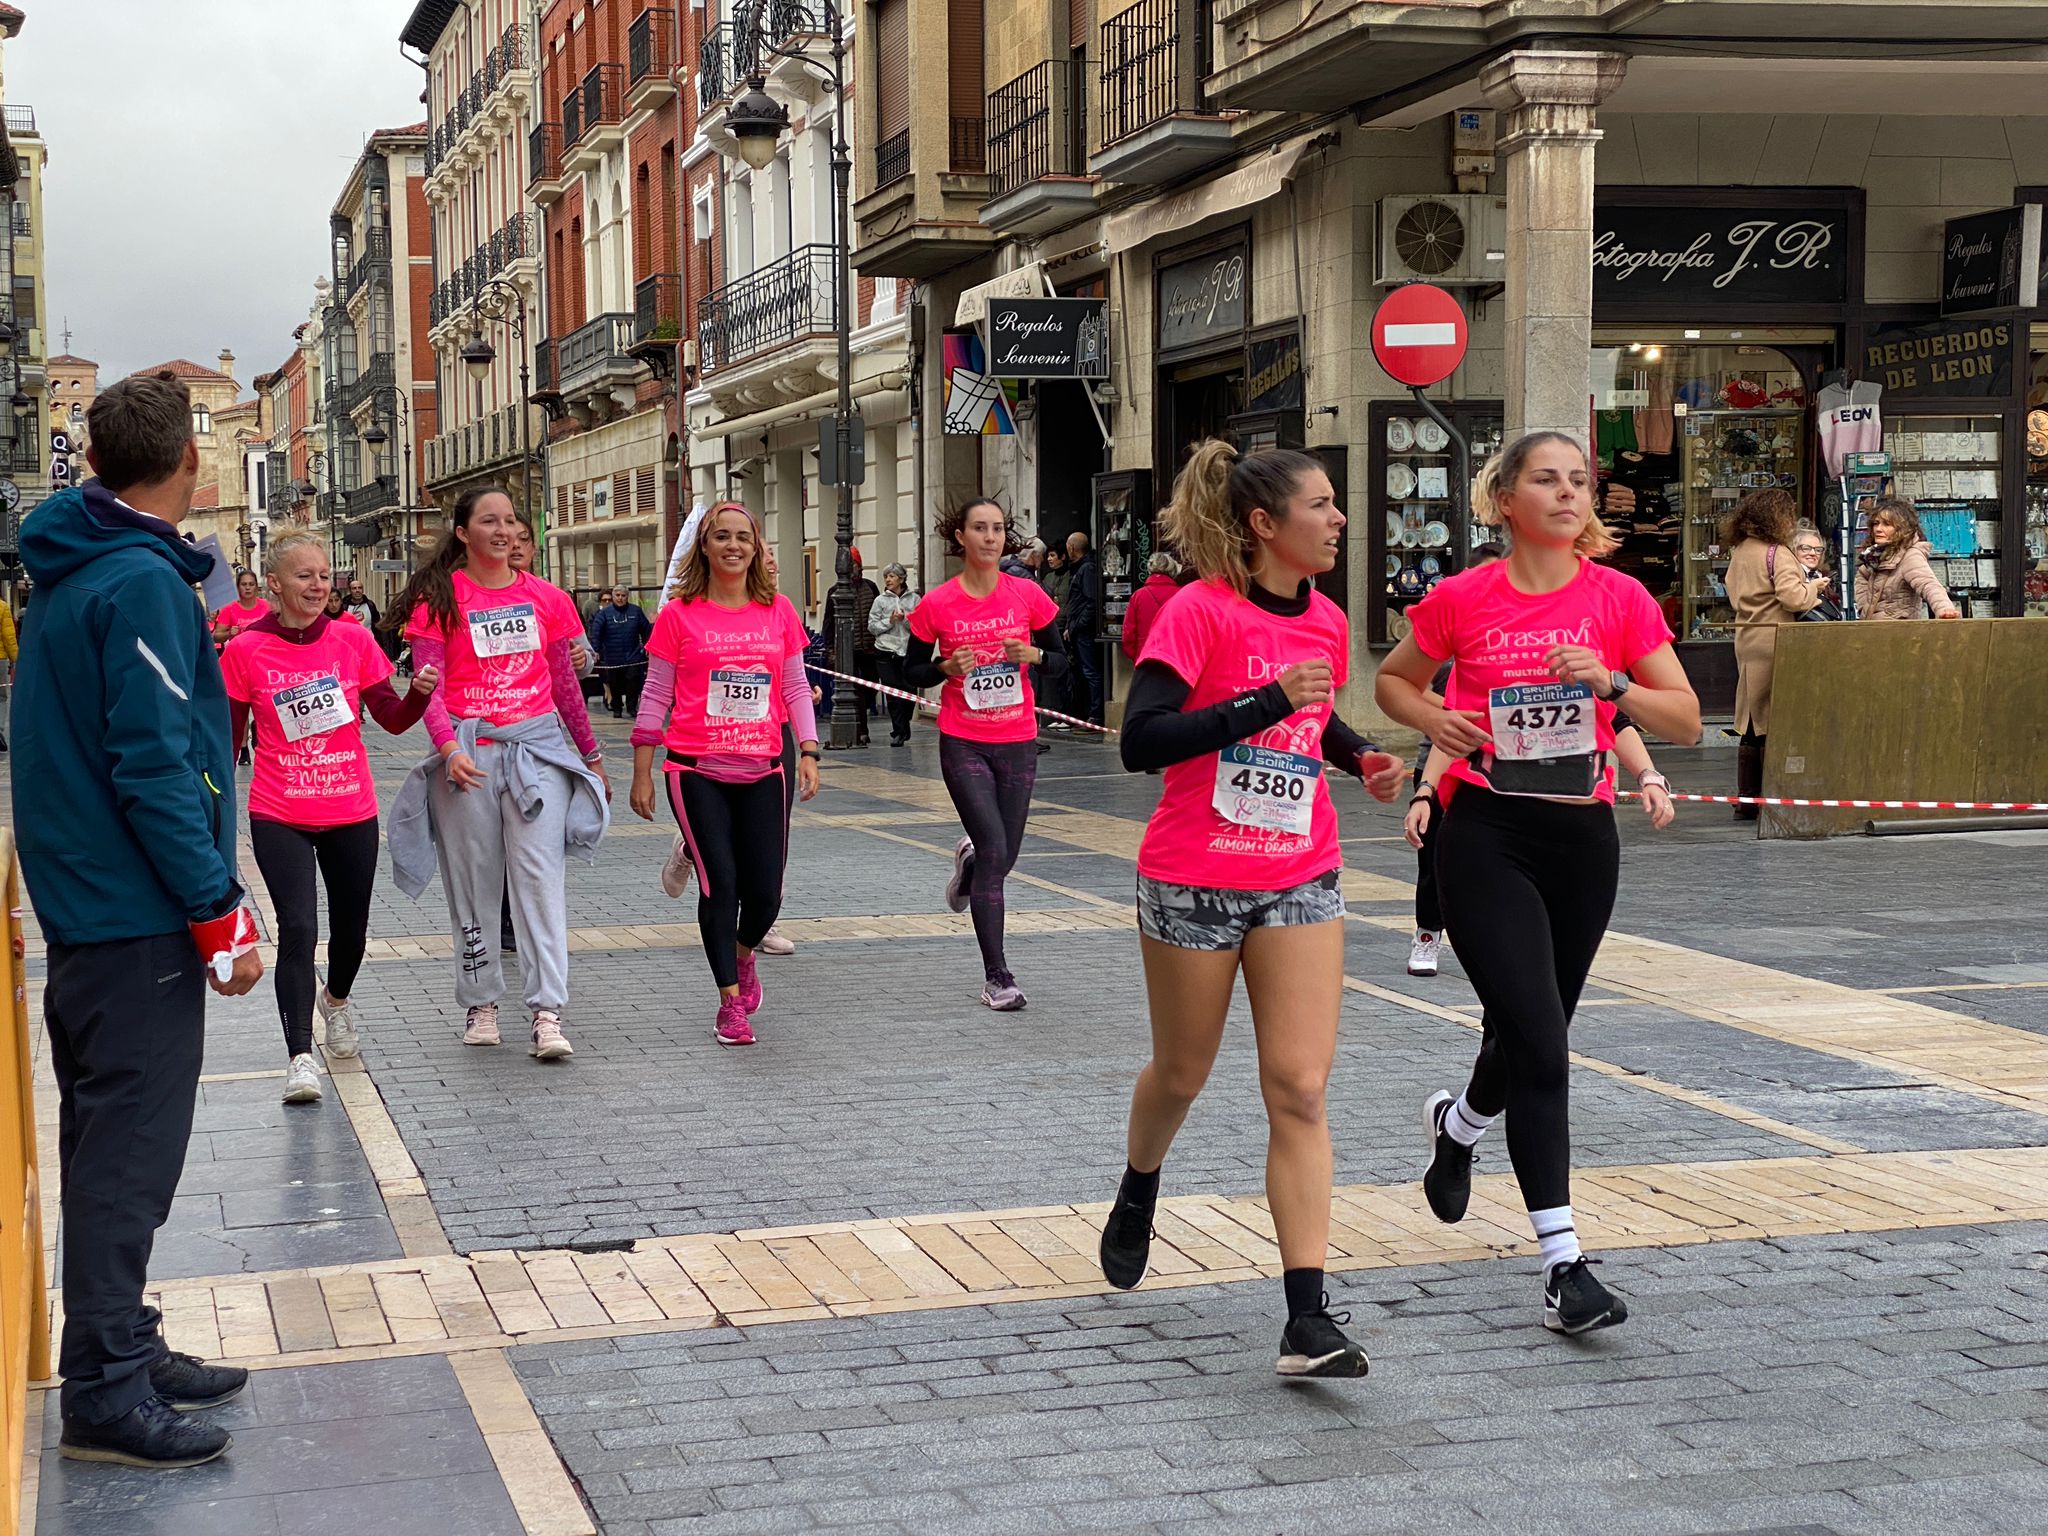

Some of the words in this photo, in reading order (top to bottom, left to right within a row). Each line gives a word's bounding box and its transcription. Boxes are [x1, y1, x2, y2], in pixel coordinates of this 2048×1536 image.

[1947, 233, 1993, 267] Regalos
[1946, 274, 1995, 300] Souvenir
[995, 310, 1063, 340] Regalos
[996, 344, 1071, 365] Souvenir
[1867, 325, 2010, 367] RECUERDOS
[1249, 347, 1300, 400] REGALOS
[1885, 367, 1917, 390] DE
[1930, 354, 1993, 383] LEON
[1831, 408, 1873, 425] LEON
[489, 610, 528, 619] solitium
[954, 608, 1015, 635] Drasanvi
[481, 619, 527, 637] 1648
[705, 626, 770, 645] Drasanvi
[1486, 617, 1592, 650] Drasanvi
[267, 661, 341, 685] Drasanvi
[731, 675, 766, 683] solitium
[981, 666, 1015, 675] solitium
[293, 682, 319, 692] GRUPO
[294, 683, 333, 698] solitium
[971, 675, 1015, 691] 4200
[1522, 685, 1563, 694] GRUPO
[464, 688, 485, 699] VIII
[723, 685, 759, 700] 1381
[1523, 689, 1584, 703] solitium
[288, 693, 335, 718] 1649
[1507, 704, 1581, 730] 4372
[719, 727, 765, 746] Mujer
[278, 754, 299, 767] VIII
[301, 750, 357, 767] CARRERA
[1256, 749, 1294, 761] GRUPO
[1255, 757, 1310, 774] solitium
[299, 769, 348, 788] Mujer
[1231, 769, 1304, 801] 4380
[321, 784, 361, 796] DRASANVI
[1209, 837, 1257, 851] ALMOM
[1264, 836, 1313, 853] DRASANVI
